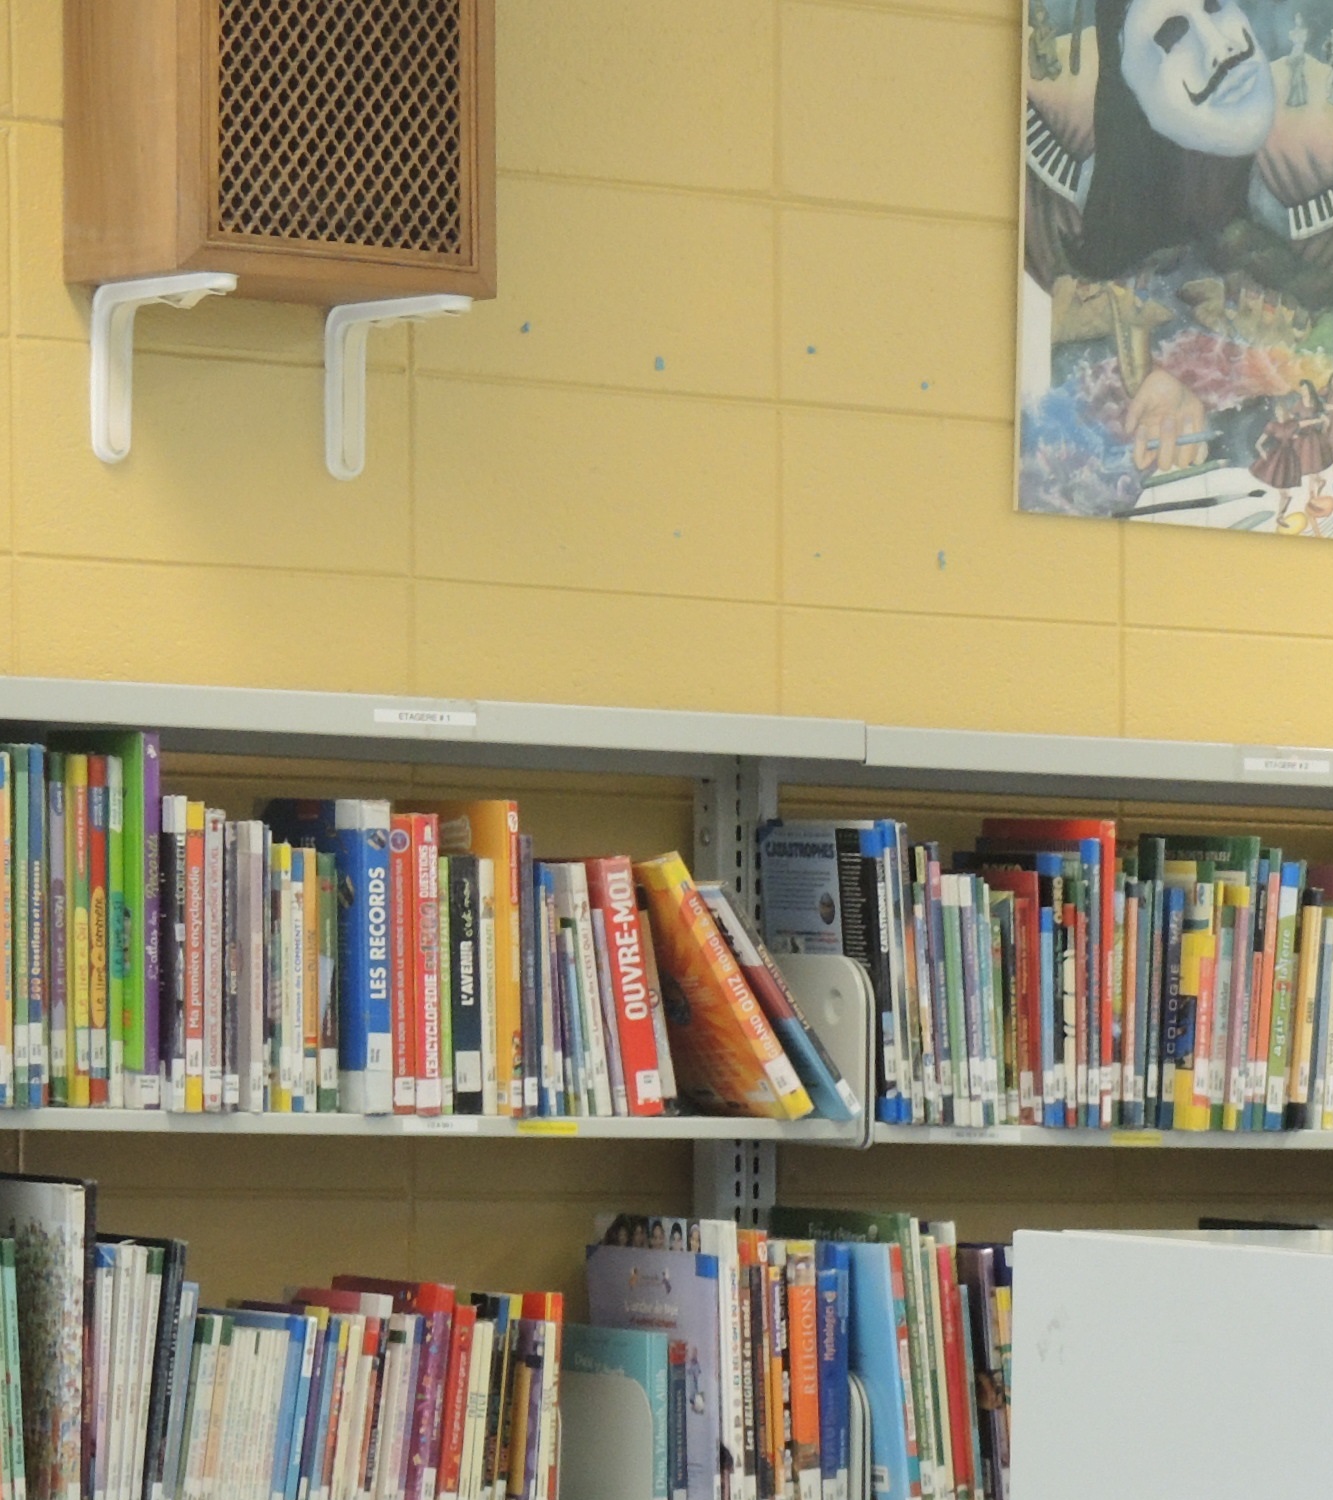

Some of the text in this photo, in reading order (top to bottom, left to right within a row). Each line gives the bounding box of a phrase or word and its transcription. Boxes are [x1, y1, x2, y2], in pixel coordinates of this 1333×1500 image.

[367, 866, 388, 1000] LES RECORDS
[687, 896, 705, 917] OR
[187, 865, 203, 1029] Ma première encyclopédie
[460, 940, 475, 1006] L'AVENIR
[606, 870, 648, 1020] OUVRE-MOI
[707, 929, 732, 973] ROUGE
[726, 974, 756, 1013] QUIZ
[1166, 964, 1179, 1063] COLOGIE
[748, 1014, 779, 1059] GRAND
[799, 1287, 817, 1396] RELIGIONS
[742, 1360, 753, 1427] RELIGIONS
